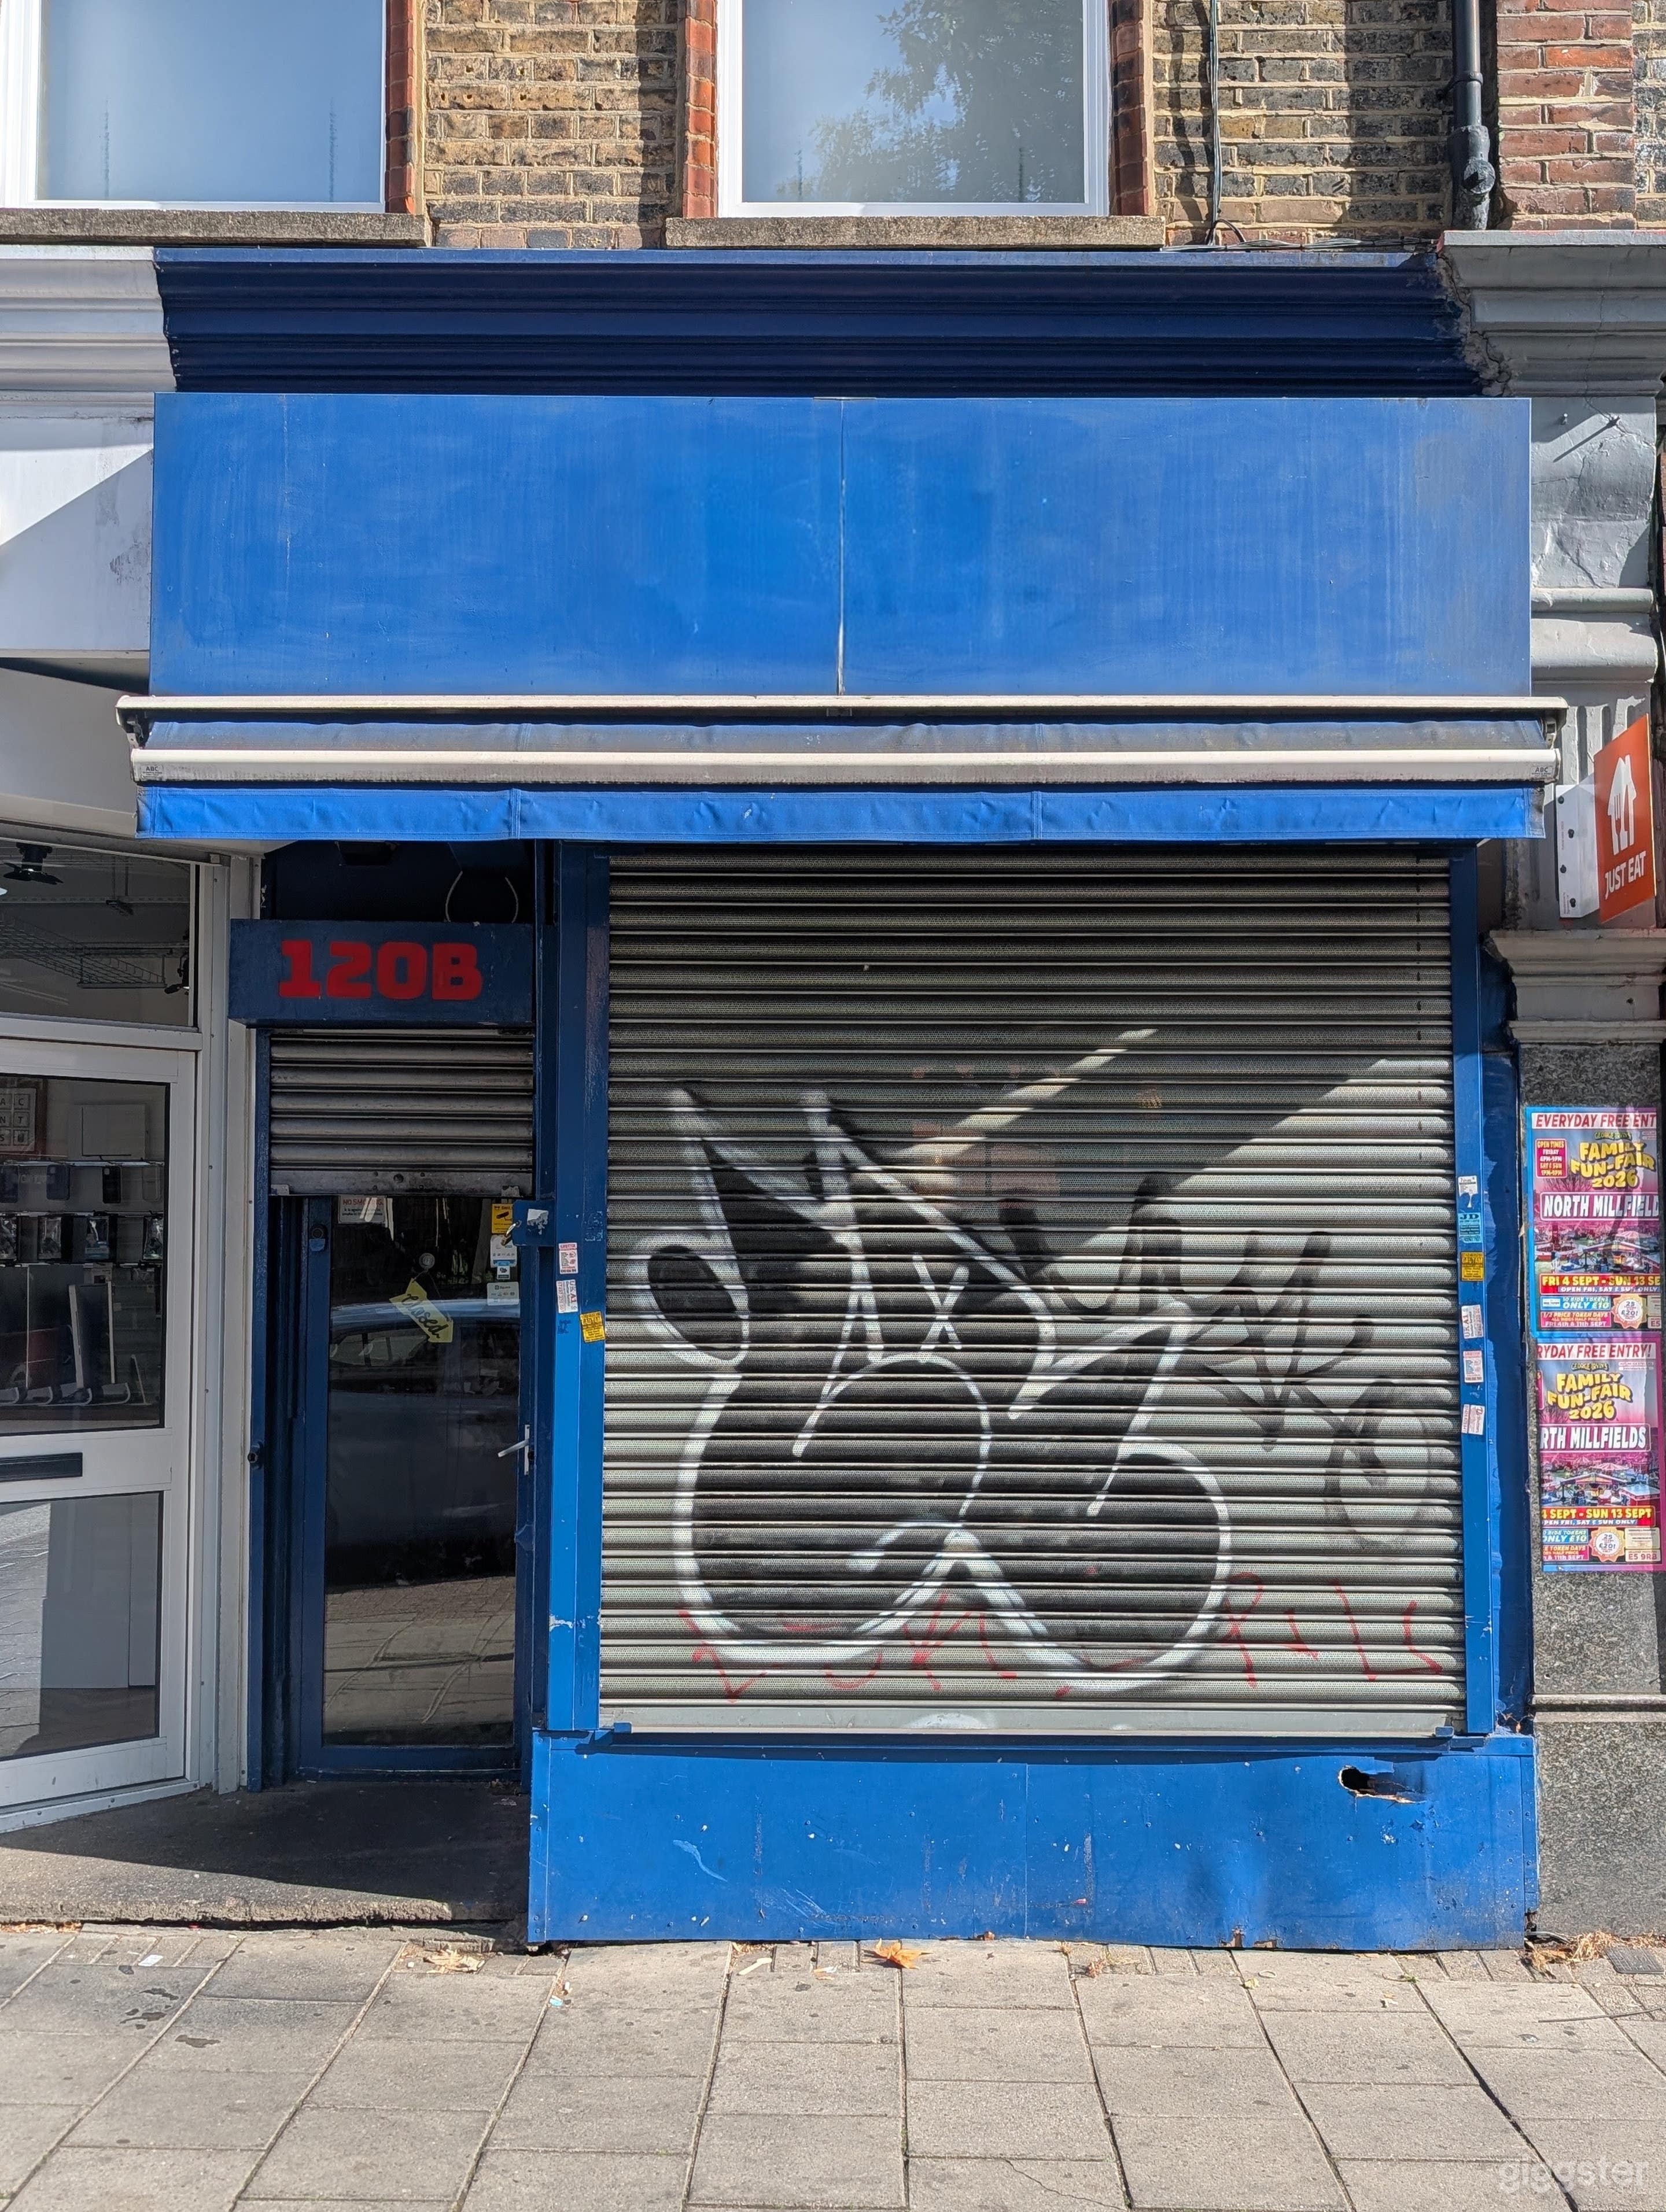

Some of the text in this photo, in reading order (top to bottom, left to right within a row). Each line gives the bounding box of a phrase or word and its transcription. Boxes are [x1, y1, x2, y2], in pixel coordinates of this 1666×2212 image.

[1605, 850, 1646, 900] JUST EAT
[279, 940, 482, 1000] 120B
[1536, 1114, 1656, 1127] EVERYDAY FREE ENT
[1579, 1142, 1645, 1162] FAMILY
[1571, 1151, 1656, 1177] FUN-FAIR
[1592, 1169, 1638, 1188] 2026
[1543, 1195, 1590, 1217] NORTH
[1542, 1276, 1560, 1286] FRI
[1562, 1276, 1570, 1286] 4
[1572, 1276, 1599, 1286] SEPT
[1609, 1276, 1631, 1286] SUN
[1634, 1276, 1645, 1286] 13
[1577, 1345, 1606, 1358] FREE
[1609, 1344, 1652, 1358] ENTRY!
[1557, 1373, 1622, 1393] FAMILY
[1547, 1383, 1632, 1409] FUN-FAIR
[1569, 1400, 1615, 1420] 2026
[1540, 1427, 1646, 1449] RTH MILLFIELDS
[1550, 1509, 1576, 1519] SEPT
[1586, 1508, 1608, 1519] SUN
[1611, 1508, 1623, 1518] 13
[1625, 1508, 1652, 1518] SEPT
